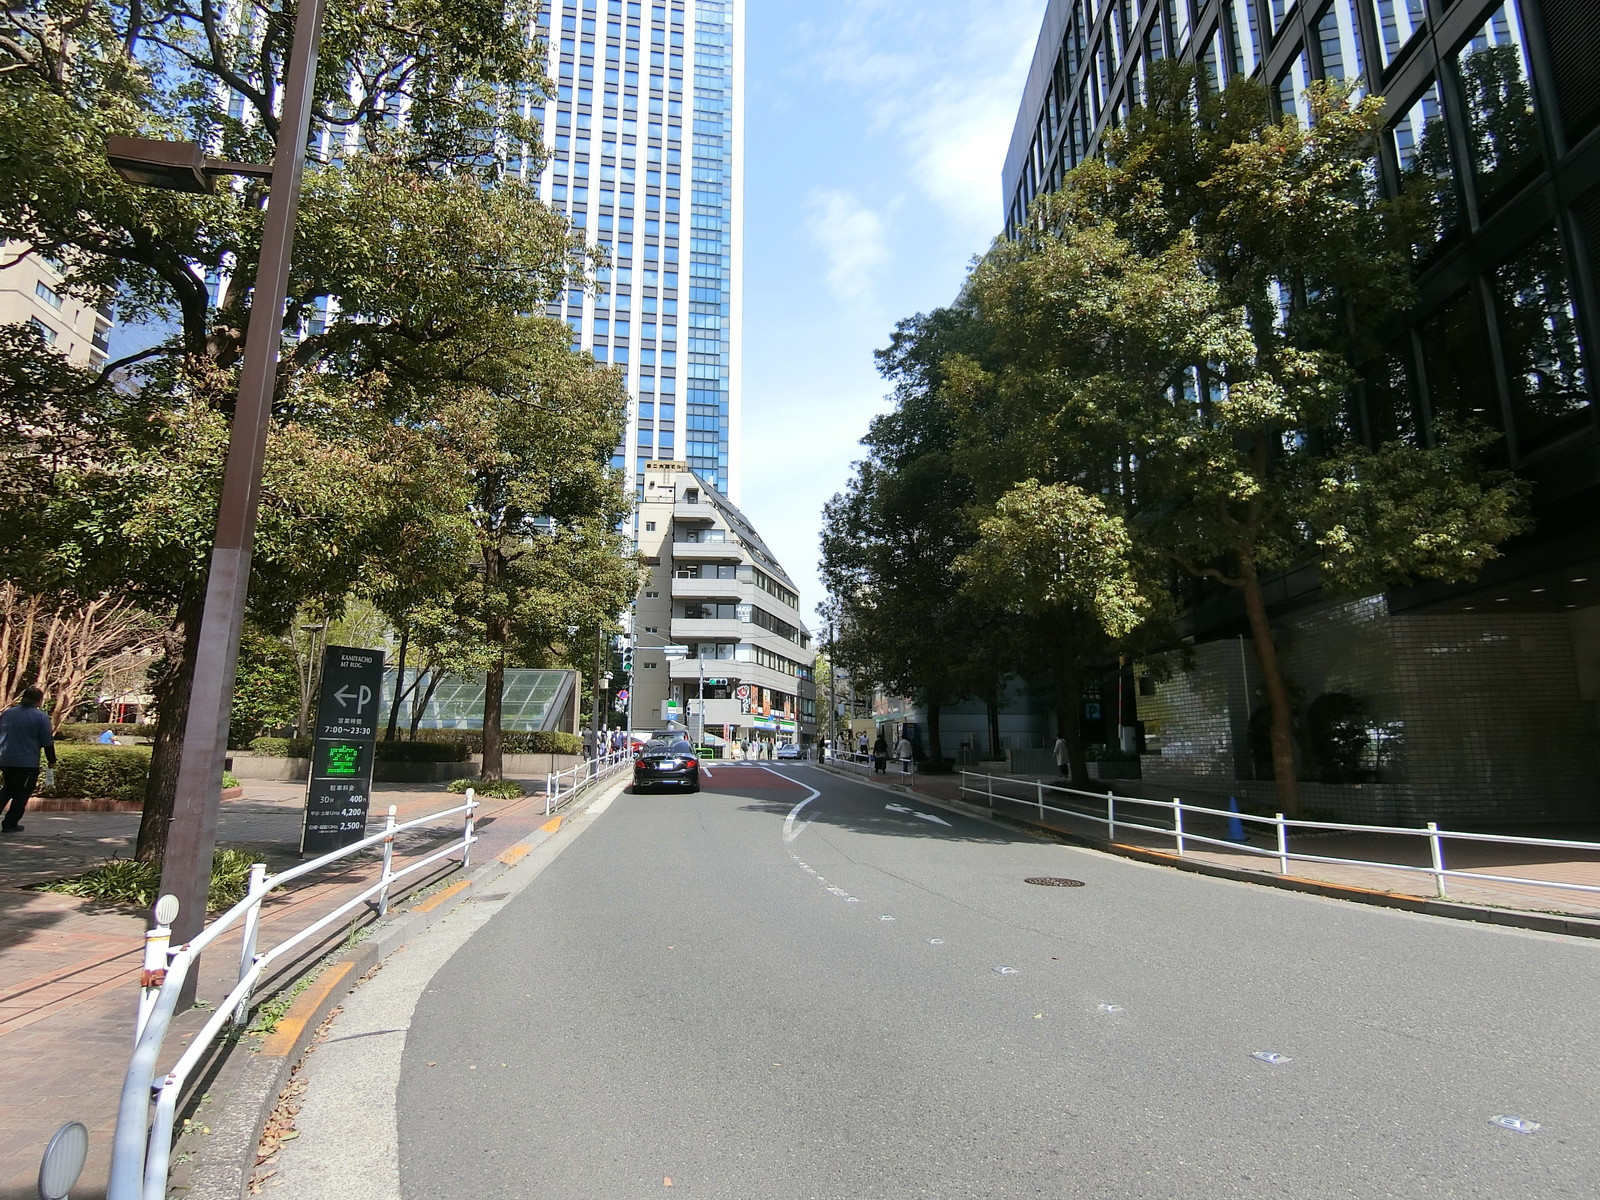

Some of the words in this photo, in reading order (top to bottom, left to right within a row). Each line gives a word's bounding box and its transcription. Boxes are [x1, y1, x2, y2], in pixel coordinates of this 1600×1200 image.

[341, 654, 373, 664] KAMIYACHO
[357, 684, 372, 714] P
[338, 717, 362, 725] 営業時間
